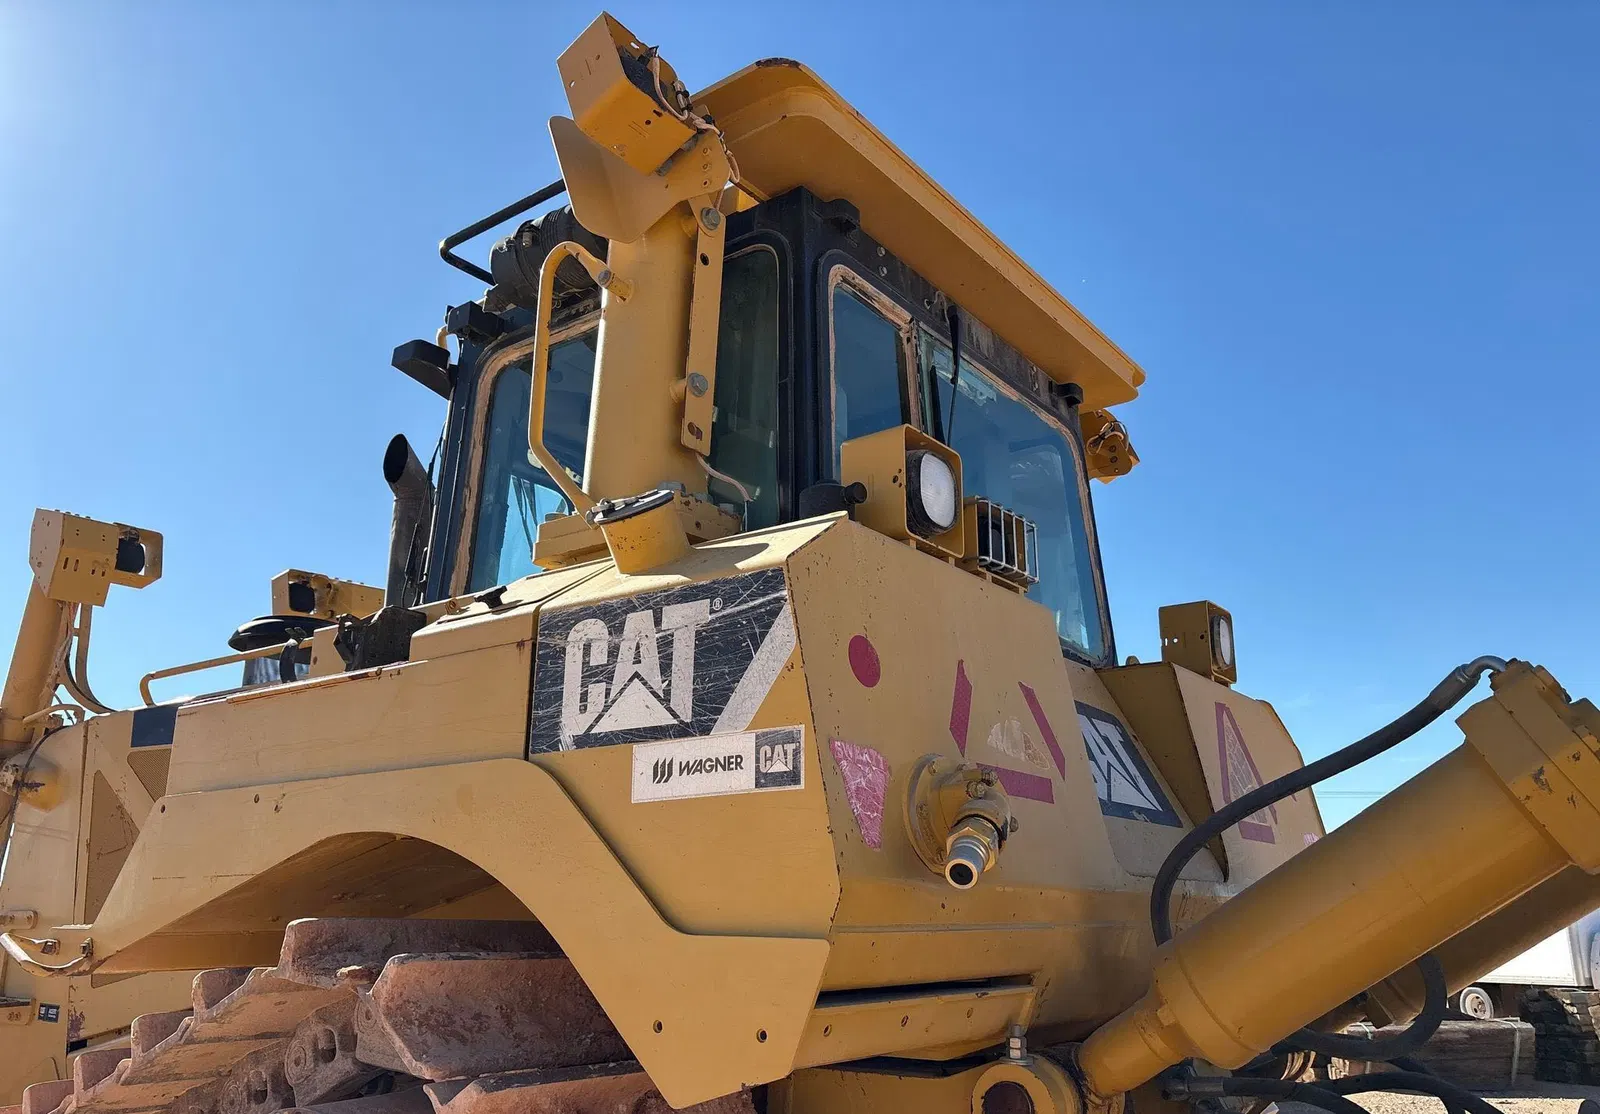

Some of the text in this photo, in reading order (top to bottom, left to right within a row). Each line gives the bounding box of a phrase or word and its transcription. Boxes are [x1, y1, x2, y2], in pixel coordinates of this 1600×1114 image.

[561, 598, 710, 736] CAT
[678, 742, 797, 776] WAGNER CAT
